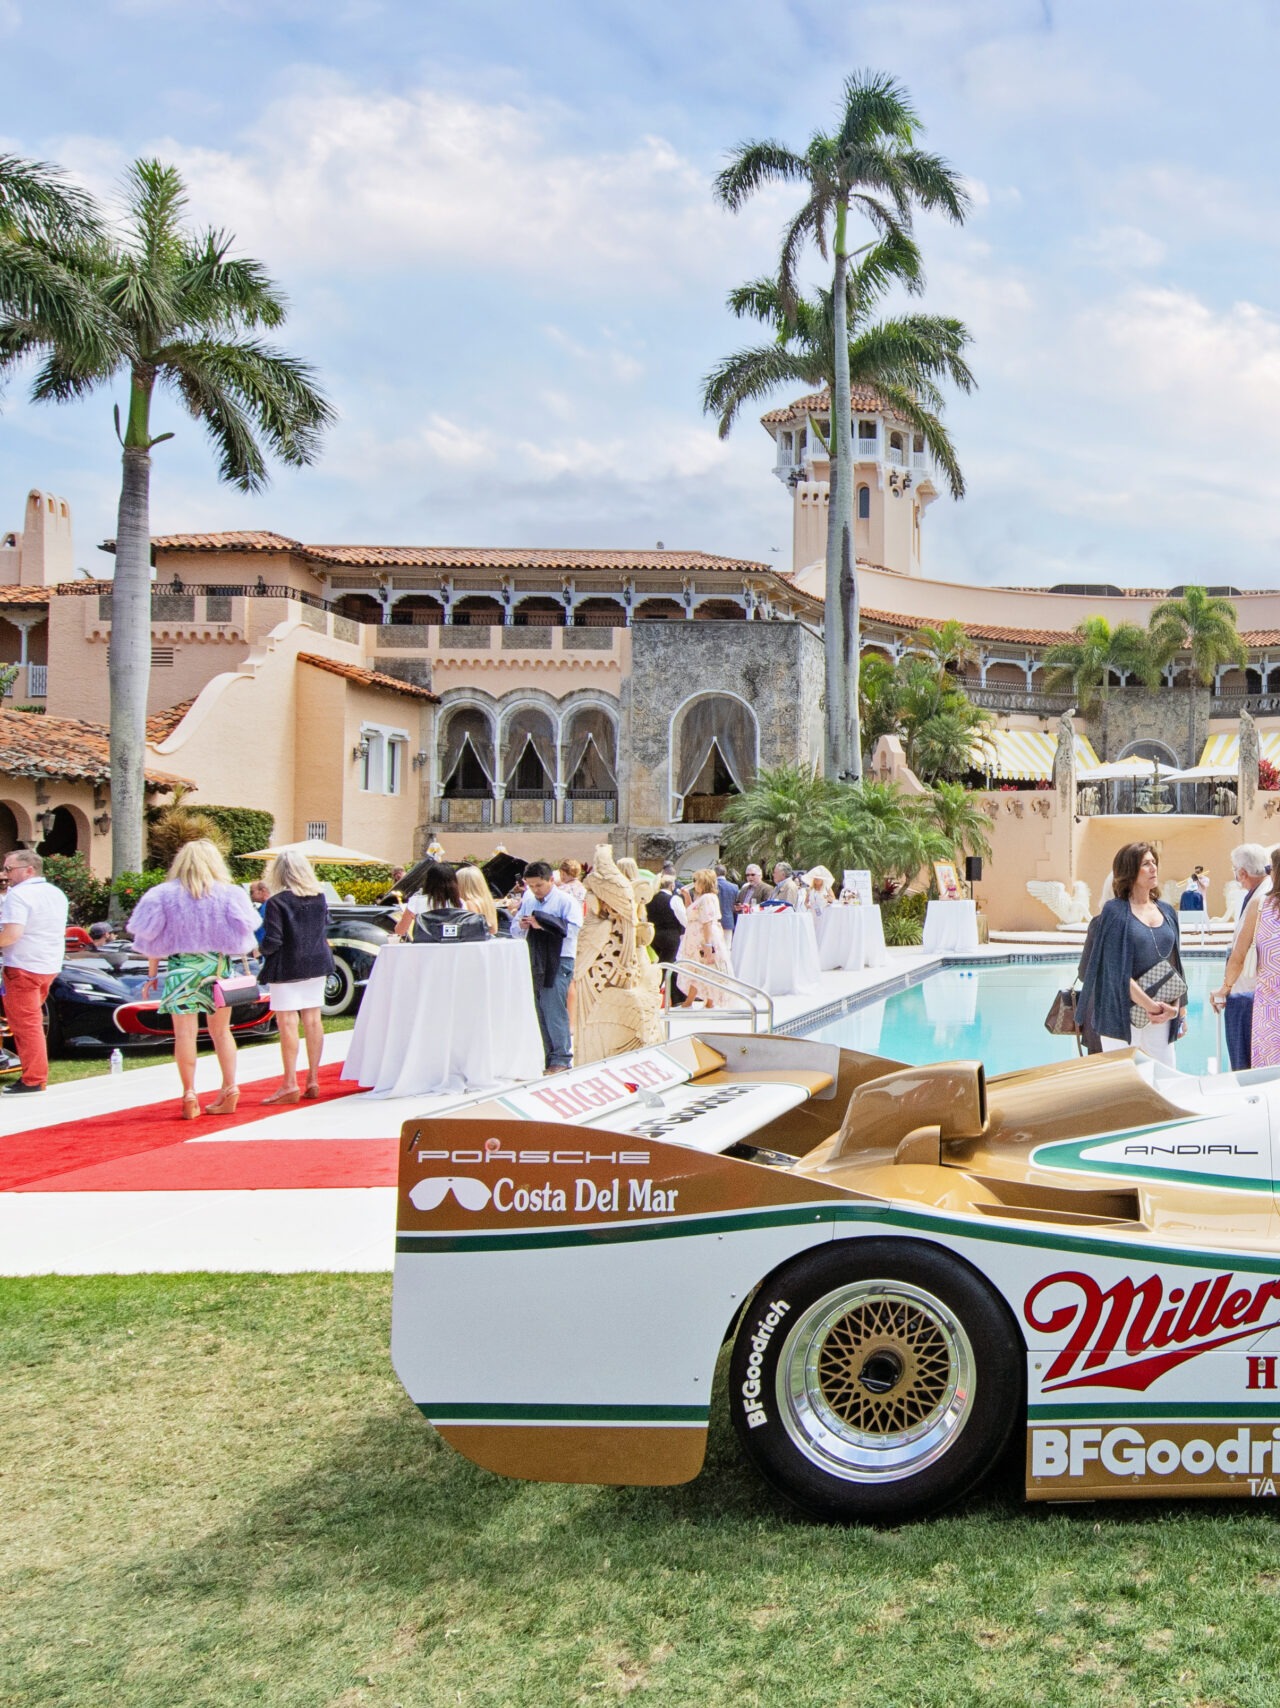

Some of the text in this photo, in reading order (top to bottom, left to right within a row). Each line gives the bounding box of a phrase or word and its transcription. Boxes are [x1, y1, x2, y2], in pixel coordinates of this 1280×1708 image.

[530, 1060, 674, 1119] HIGH LIFE
[417, 1150, 651, 1164] PORSCHE
[1124, 1145, 1259, 1155] ANDIAL
[493, 1178, 678, 1212] Costa Del Mar
[742, 1299, 791, 1429] BFGoodrich
[1247, 1478, 1277, 1496] T/A
